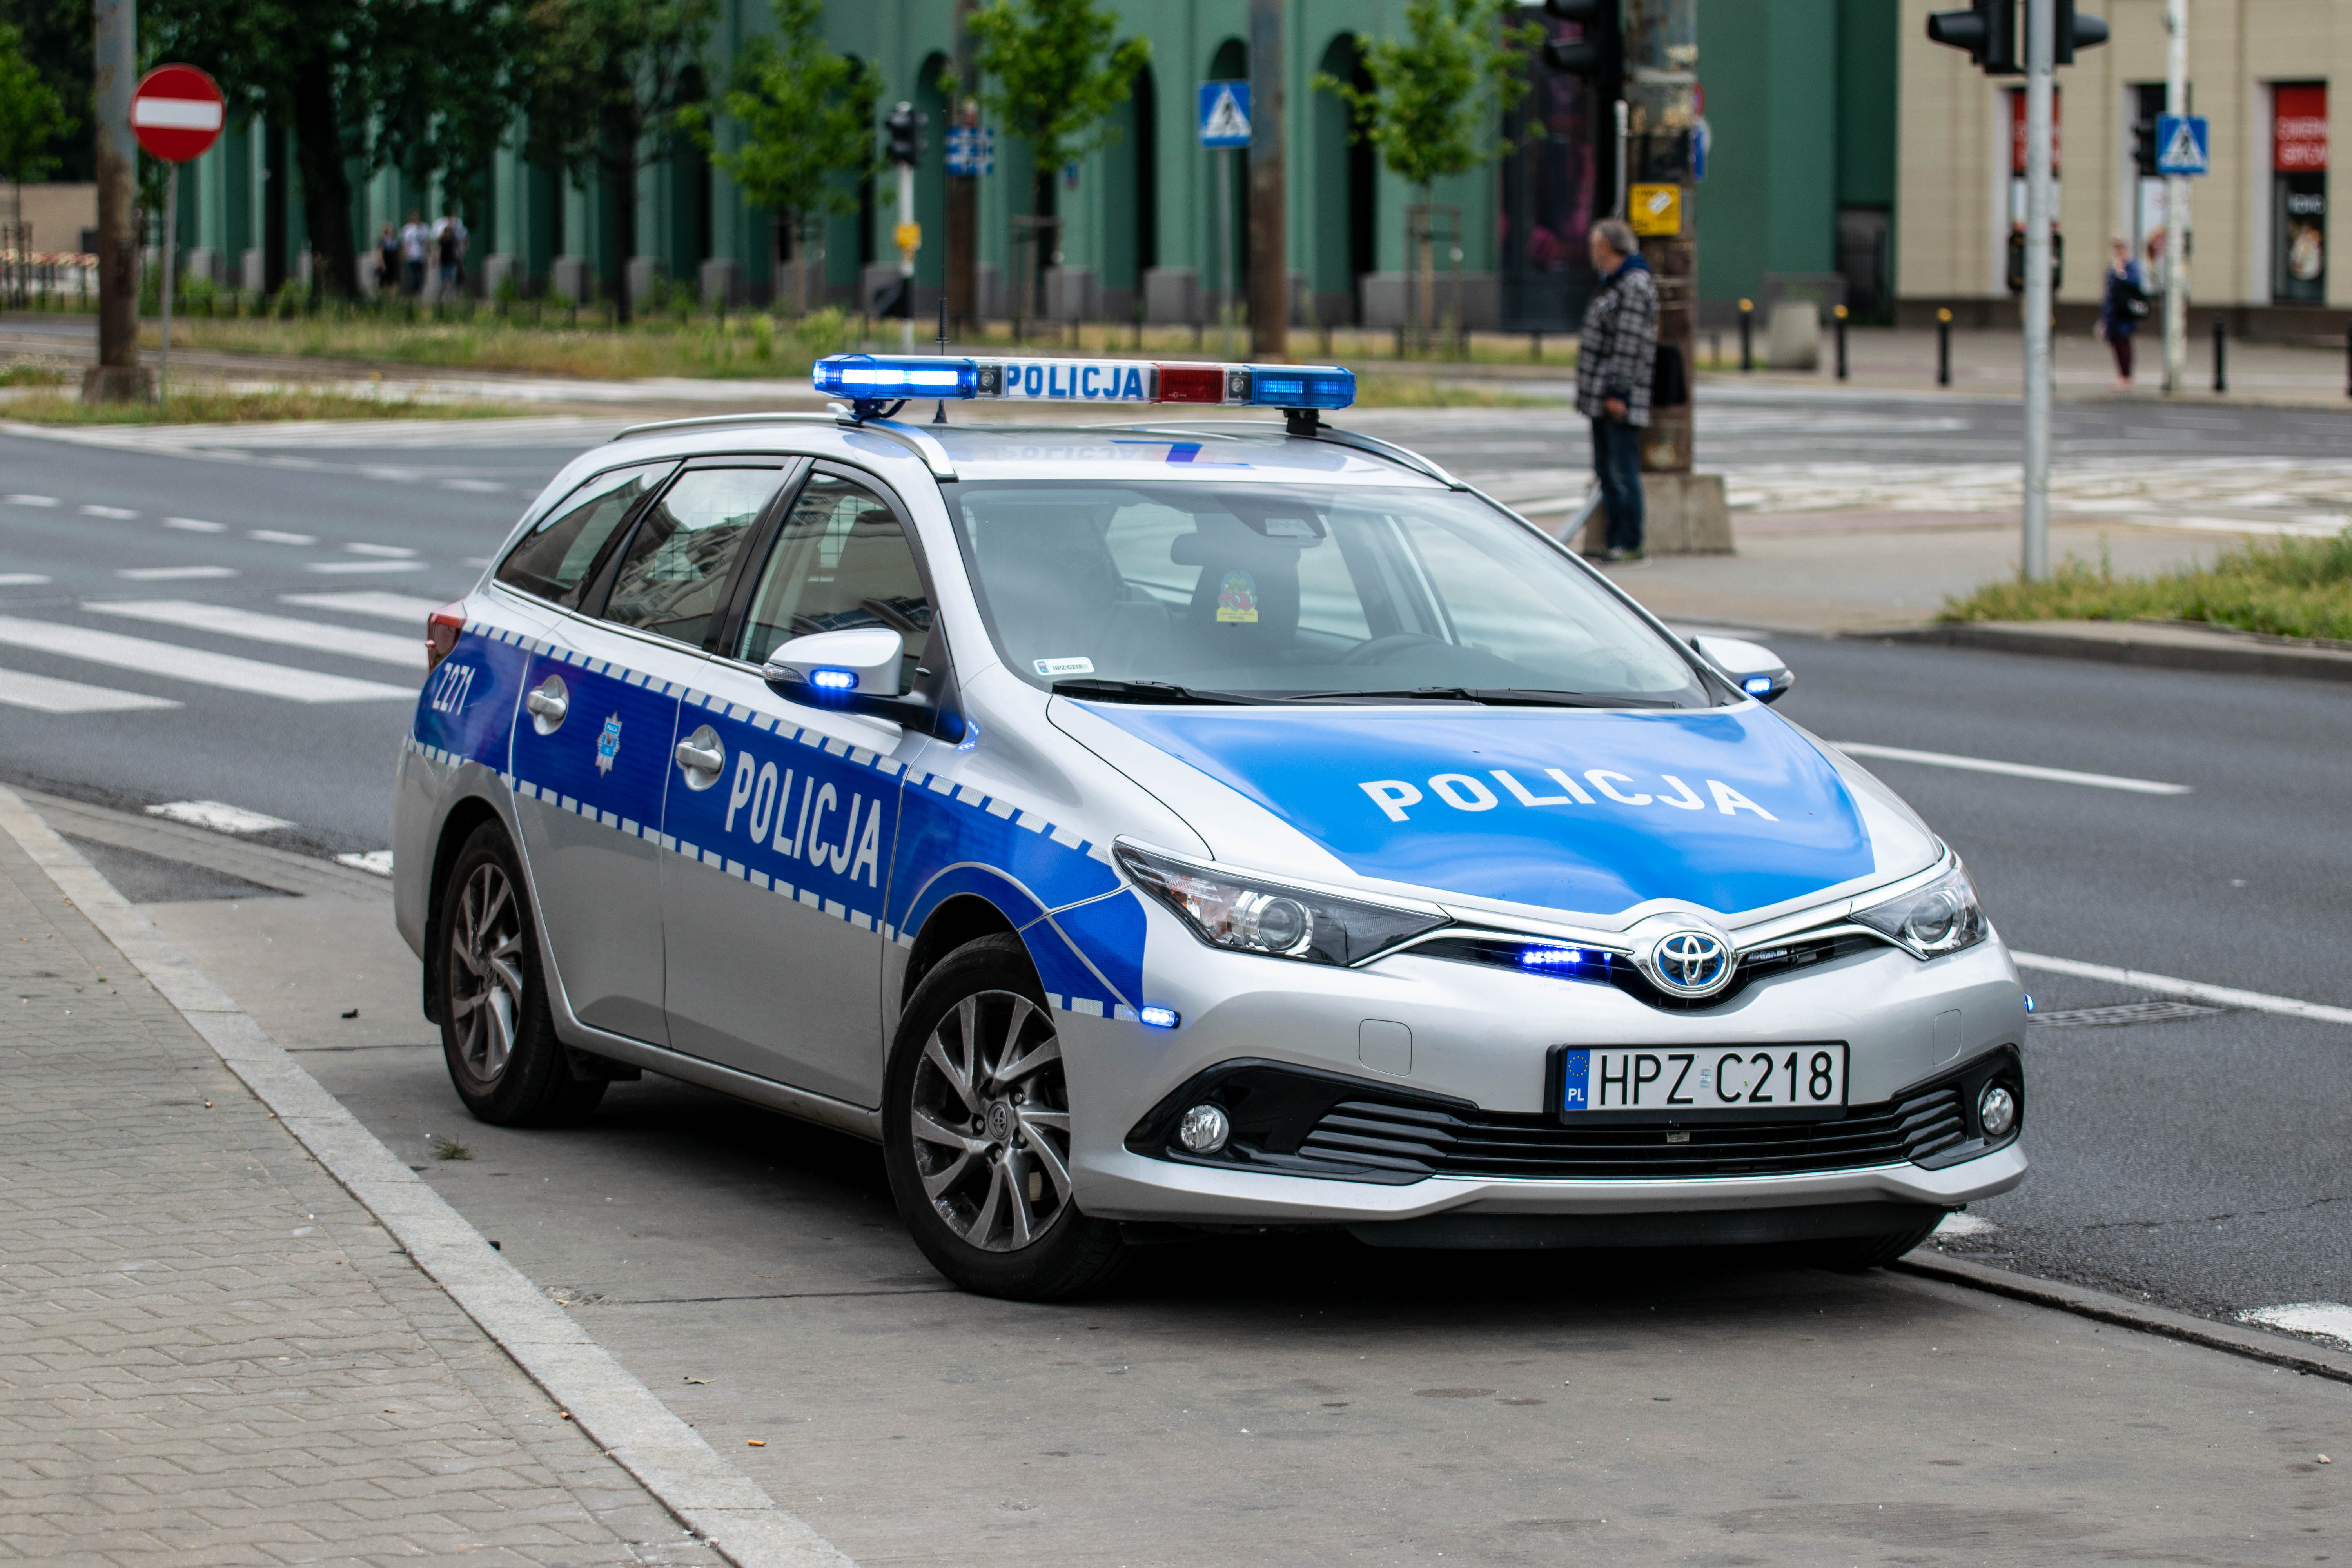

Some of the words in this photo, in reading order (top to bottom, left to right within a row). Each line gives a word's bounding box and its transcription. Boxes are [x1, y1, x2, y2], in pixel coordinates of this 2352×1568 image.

[1006, 362, 1145, 400] POLICJA
[725, 751, 881, 888] POLICJA
[1358, 768, 1780, 822] POLICJA
[1568, 1088, 1584, 1102] PL
[1600, 1053, 1695, 1105] HPZ
[1716, 1051, 1833, 1102] C218
